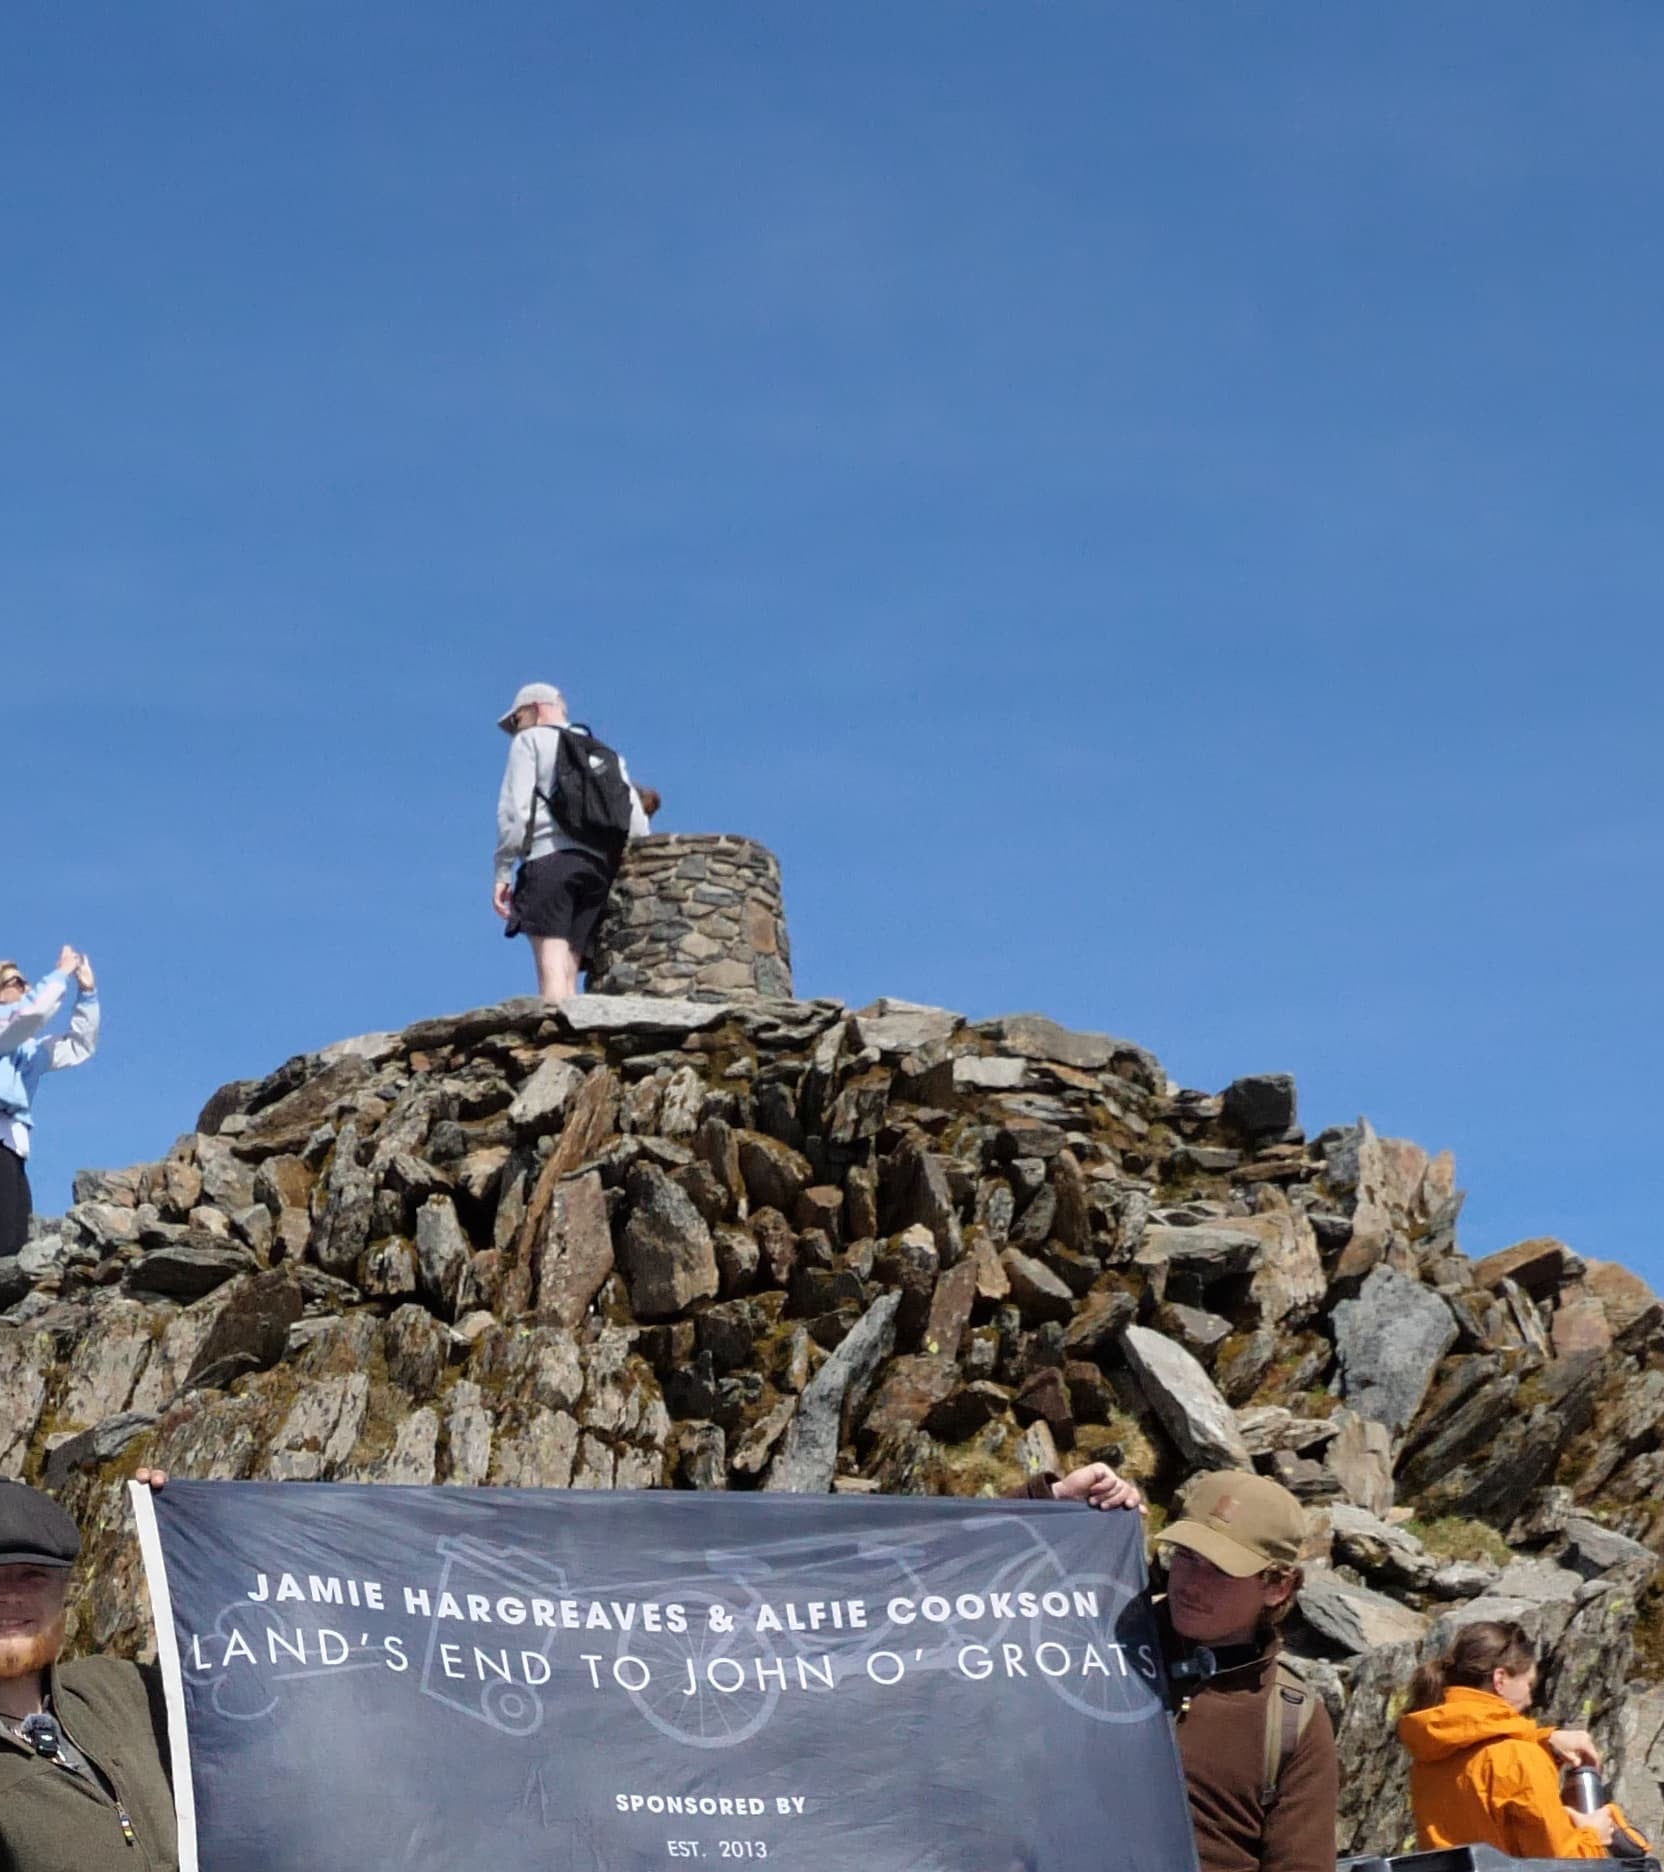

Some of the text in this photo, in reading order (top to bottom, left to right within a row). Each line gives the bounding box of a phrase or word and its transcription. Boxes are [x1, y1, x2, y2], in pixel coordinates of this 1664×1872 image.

[247, 1572, 1099, 1633] JAMIE HARGREAVES & ALFIE COOKSON
[189, 1626, 1158, 1696] LAND'S END TO JOHN O' GROATS
[615, 1793, 806, 1815] SPONSORED BY
[666, 1840, 768, 1859] EST. 2013
